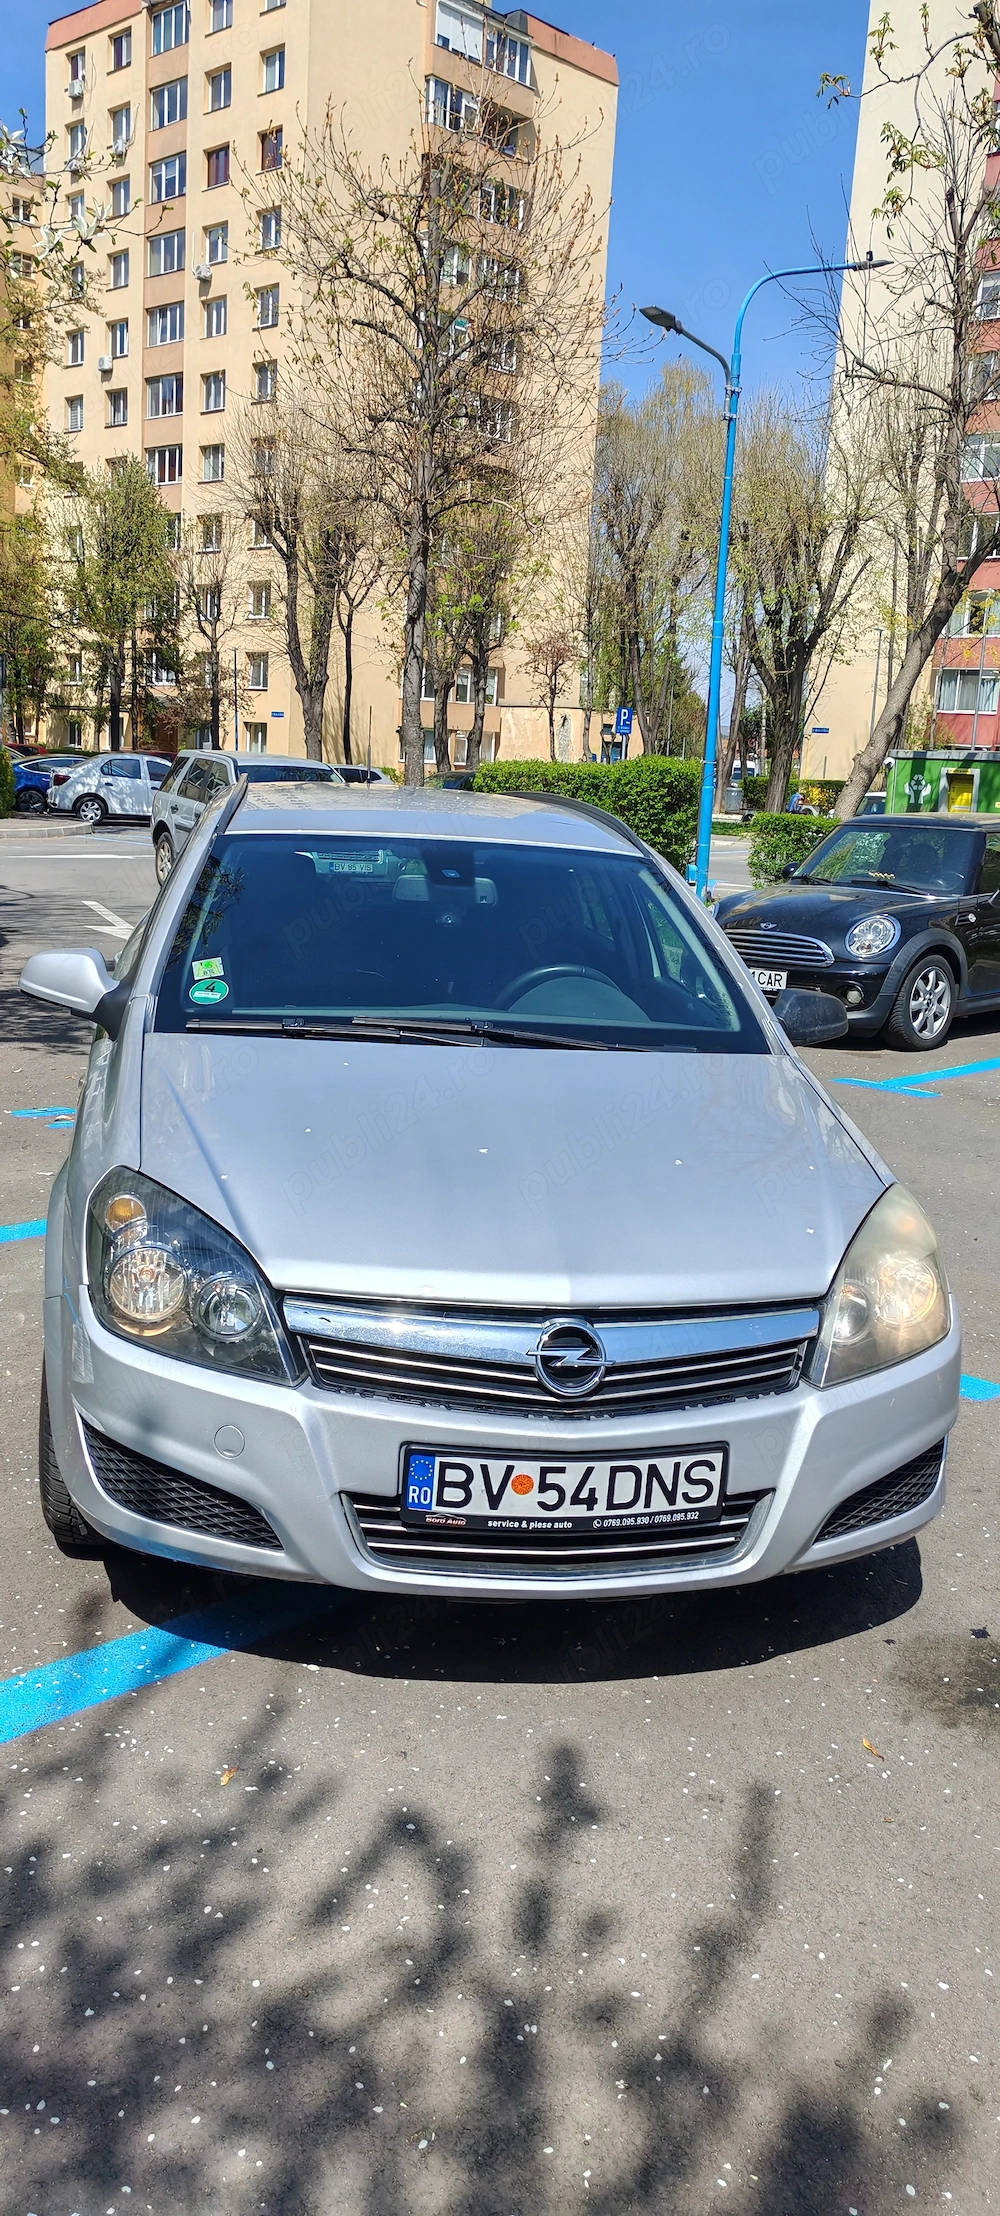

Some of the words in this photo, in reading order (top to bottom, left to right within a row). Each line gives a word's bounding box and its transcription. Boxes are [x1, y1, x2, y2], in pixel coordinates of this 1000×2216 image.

[621, 709, 628, 725] P
[334, 863, 346, 871] BV
[205, 981, 216, 992] 4
[436, 1460, 515, 1510] BV
[537, 1460, 716, 1512] 54DNS
[409, 1486, 431, 1504] RO
[487, 1520, 519, 1528] service
[521, 1520, 528, 1528] &
[553, 1521, 572, 1529] auto
[603, 1516, 650, 1527] 0769.095.930
[654, 1511, 699, 1523] 0769.095.932
